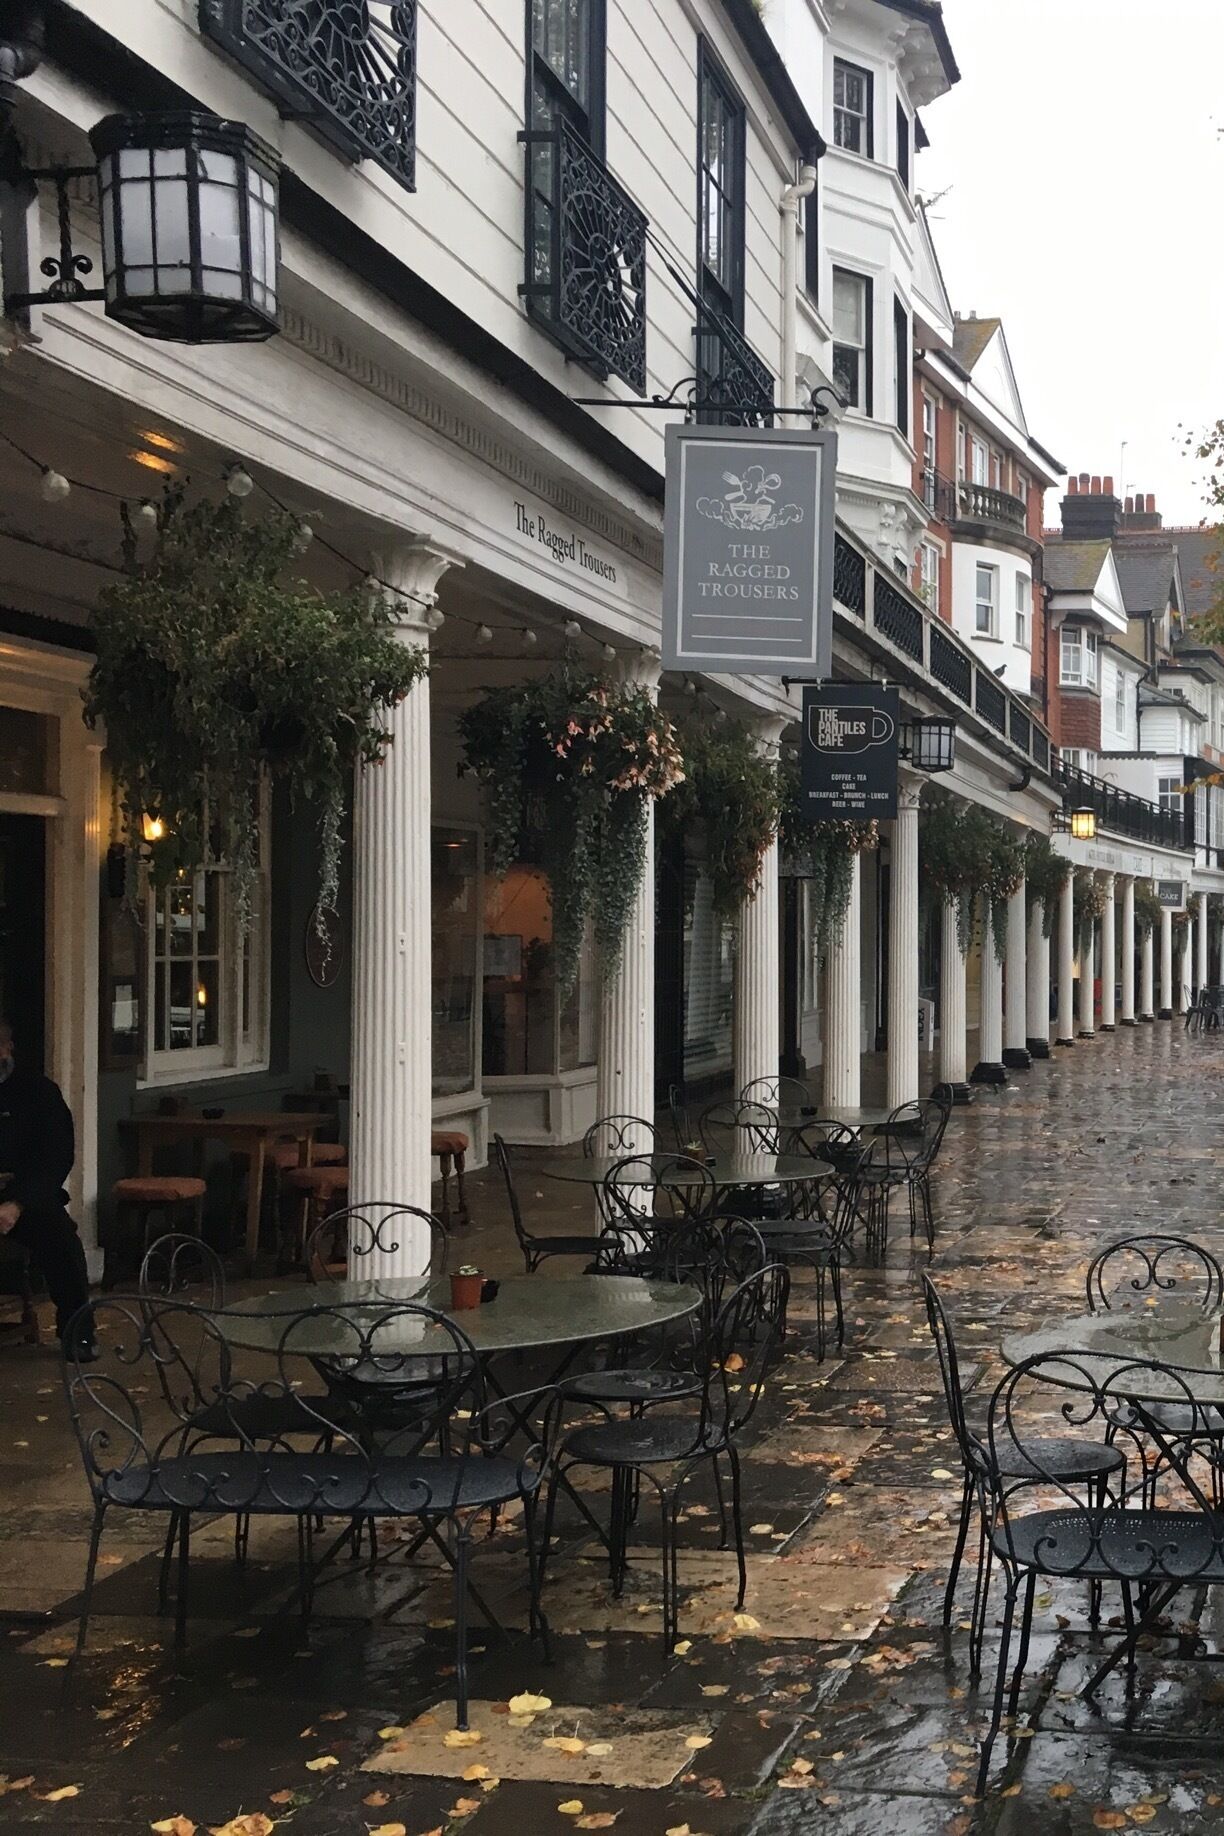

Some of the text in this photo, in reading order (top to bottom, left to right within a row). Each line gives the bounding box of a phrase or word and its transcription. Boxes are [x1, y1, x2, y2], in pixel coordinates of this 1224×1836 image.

[514, 501, 617, 583] The Ragged Trousers
[728, 544, 770, 559] THE
[708, 562, 790, 579] RAGGED
[698, 582, 799, 600] TROUSERS
[818, 708, 839, 721] THE
[818, 721, 866, 735] PANTILES
[818, 733, 844, 747] CAFE
[808, 791, 839, 799] BREAKFAST
[870, 792, 889, 800] LUNCH
